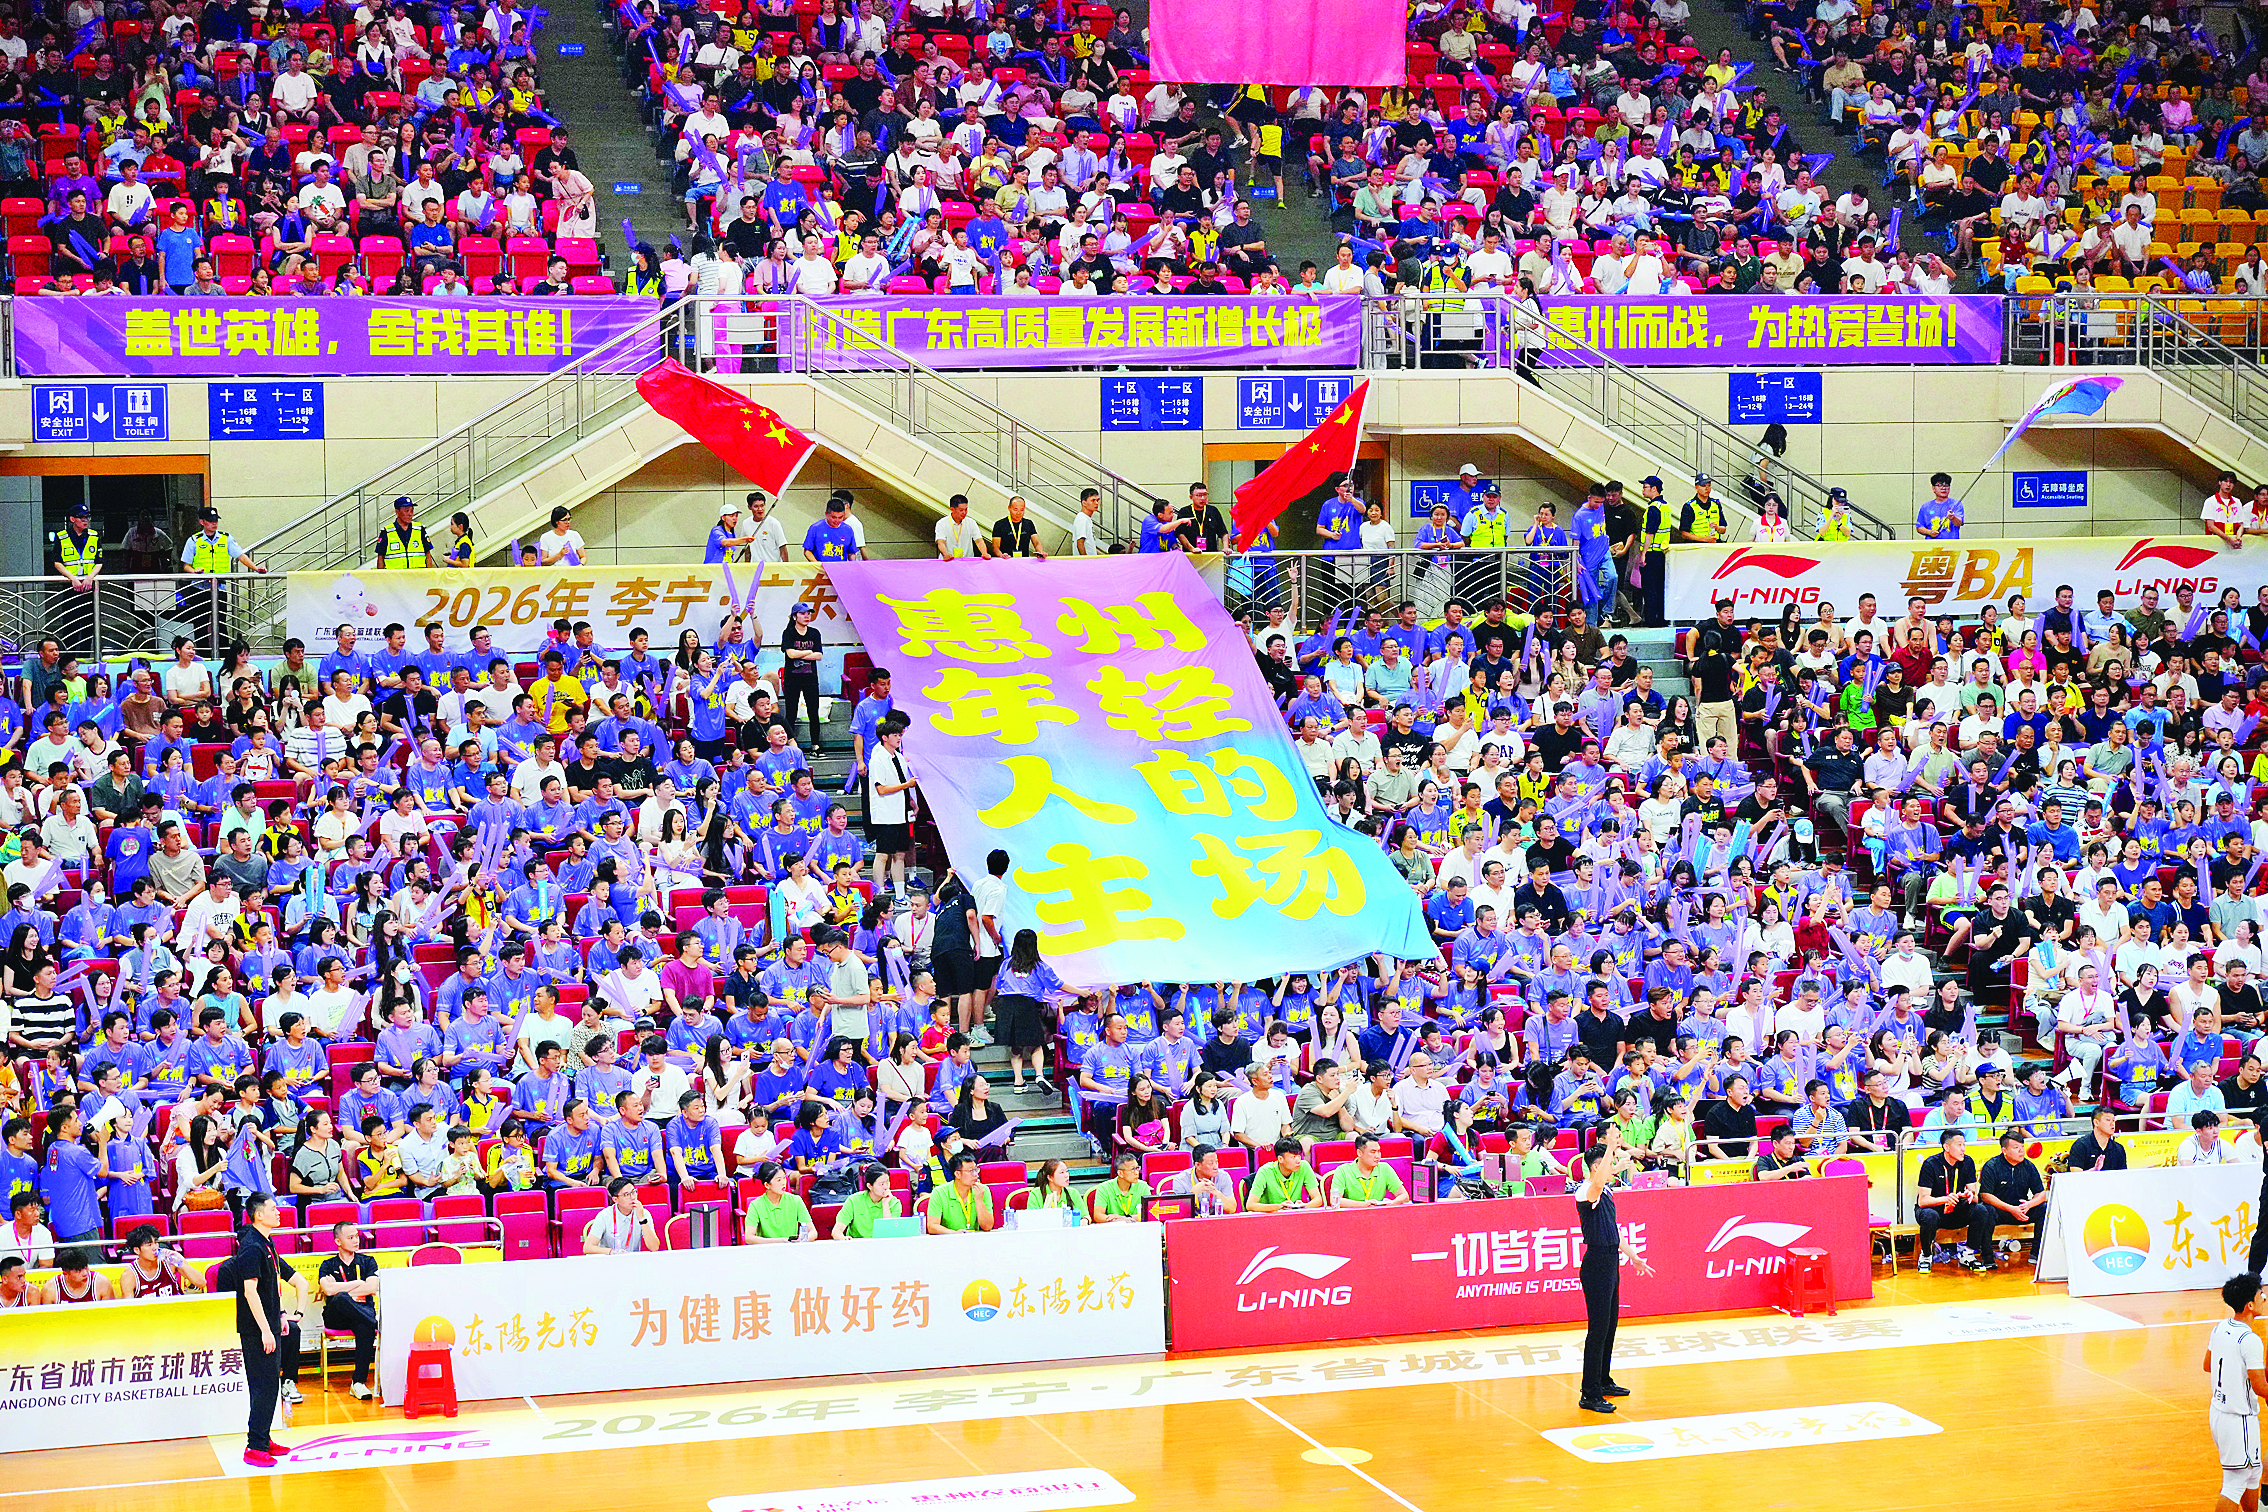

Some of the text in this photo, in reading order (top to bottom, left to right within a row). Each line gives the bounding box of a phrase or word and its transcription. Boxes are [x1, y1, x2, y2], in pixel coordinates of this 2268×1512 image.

[122, 415, 158, 427] 卫生间
[1243, 406, 1281, 417] 安全出口
[1252, 417, 1272, 425] EXIT
[40, 416, 84, 428] 安全出口
[51, 428, 73, 437] EXIT
[125, 428, 156, 436] TOILET
[2041, 483, 2084, 493] 无障碍坐席
[1899, 547, 2033, 604] 粤BA
[414, 577, 595, 628] 2026年
[1710, 586, 1821, 605] LI-NING
[876, 588, 1208, 663] 惠州
[922, 663, 1253, 745] 年轻
[977, 747, 1298, 829] 人的
[1013, 830, 1366, 956] 主场
[2133, 1064, 2157, 1082] 惠州
[566, 1152, 592, 1174] 惠州
[620, 1148, 648, 1166] 惠州
[2105, 1256, 2134, 1269] HEC
[1236, 1285, 1352, 1312] LI-NING
[1455, 1282, 1523, 1299] ANYTHING
[1525, 1280, 1540, 1294] IS
[972, 1310, 991, 1319] HEC
[0, 1347, 244, 1394] 东省城市篮球联赛
[71, 1392, 101, 1405] CITY
[104, 1386, 189, 1403] BASKETBALL
[193, 1381, 244, 1396] LEAGUE
[541, 1397, 860, 1440] 2026年
[289, 1438, 490, 1462] LI-NING
